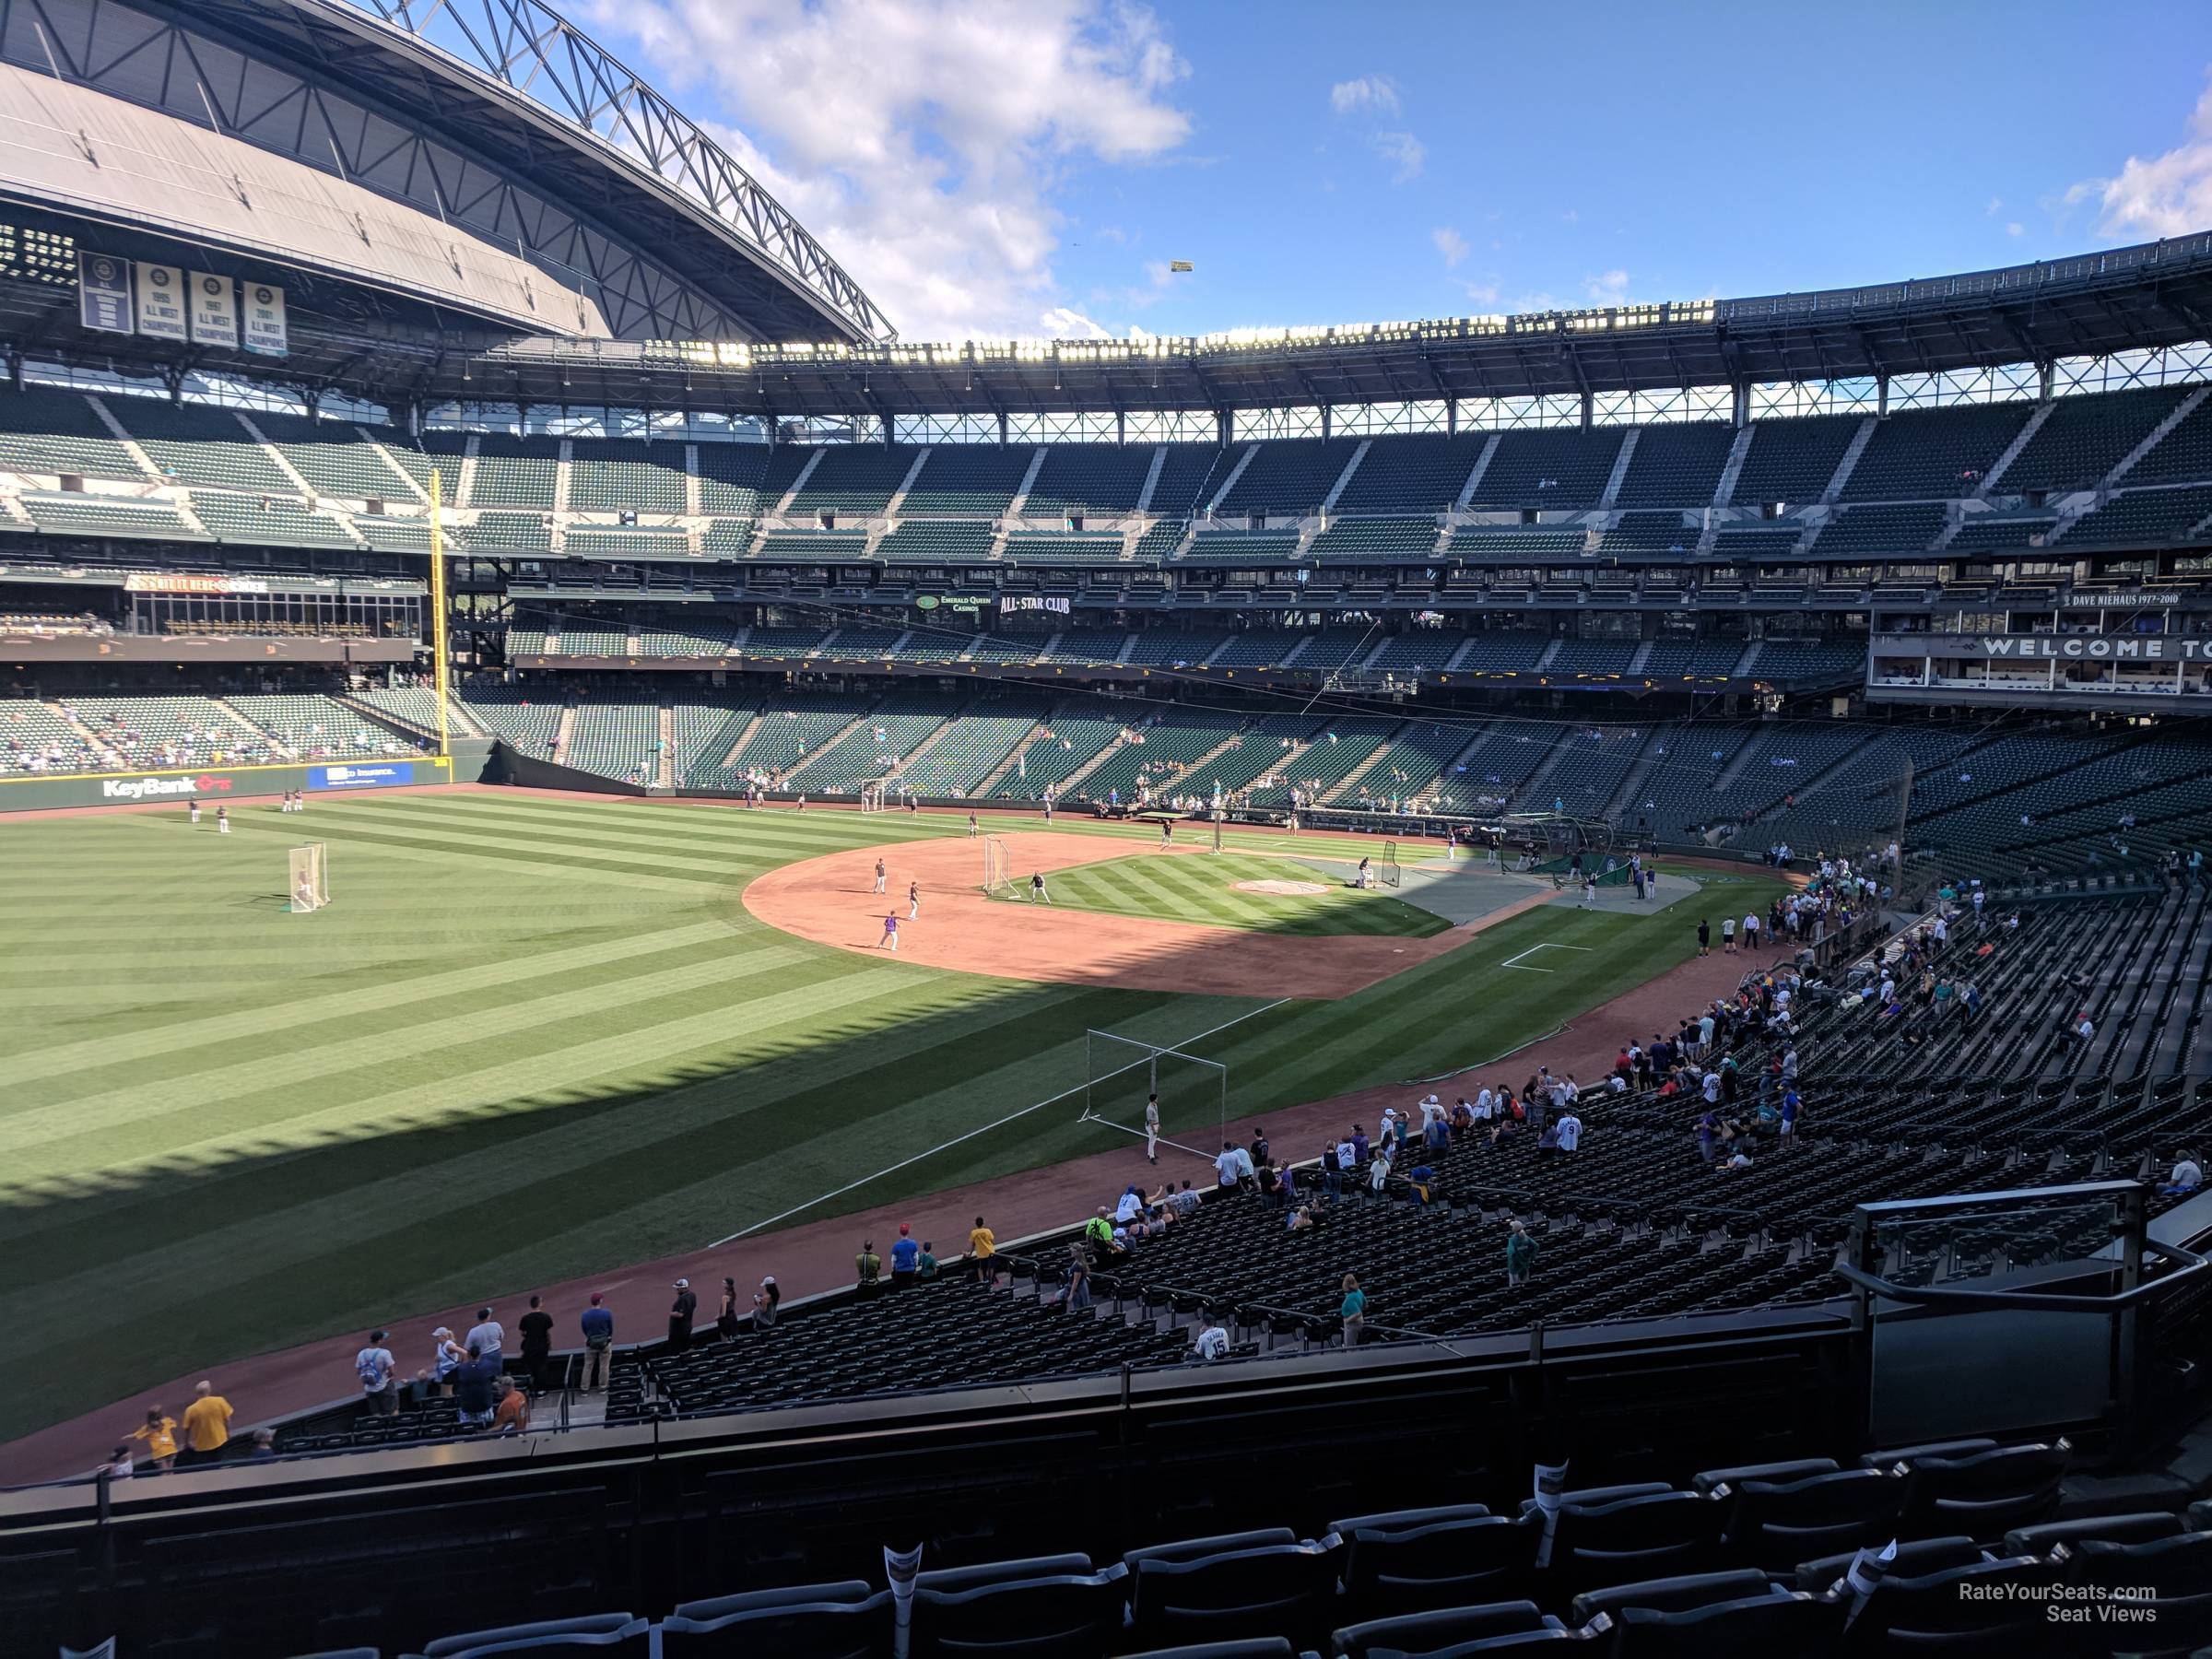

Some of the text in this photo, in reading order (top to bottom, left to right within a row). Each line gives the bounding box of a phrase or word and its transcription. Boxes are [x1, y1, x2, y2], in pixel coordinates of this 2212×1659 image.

[970, 596, 992, 605] QUEEN
[1045, 597, 1070, 615] CLUB
[2073, 594, 2179, 606] DAVE NIEHAUS 1977-2010
[1983, 638, 2163, 657] WELCOME
[102, 777, 198, 799] KeyBank
